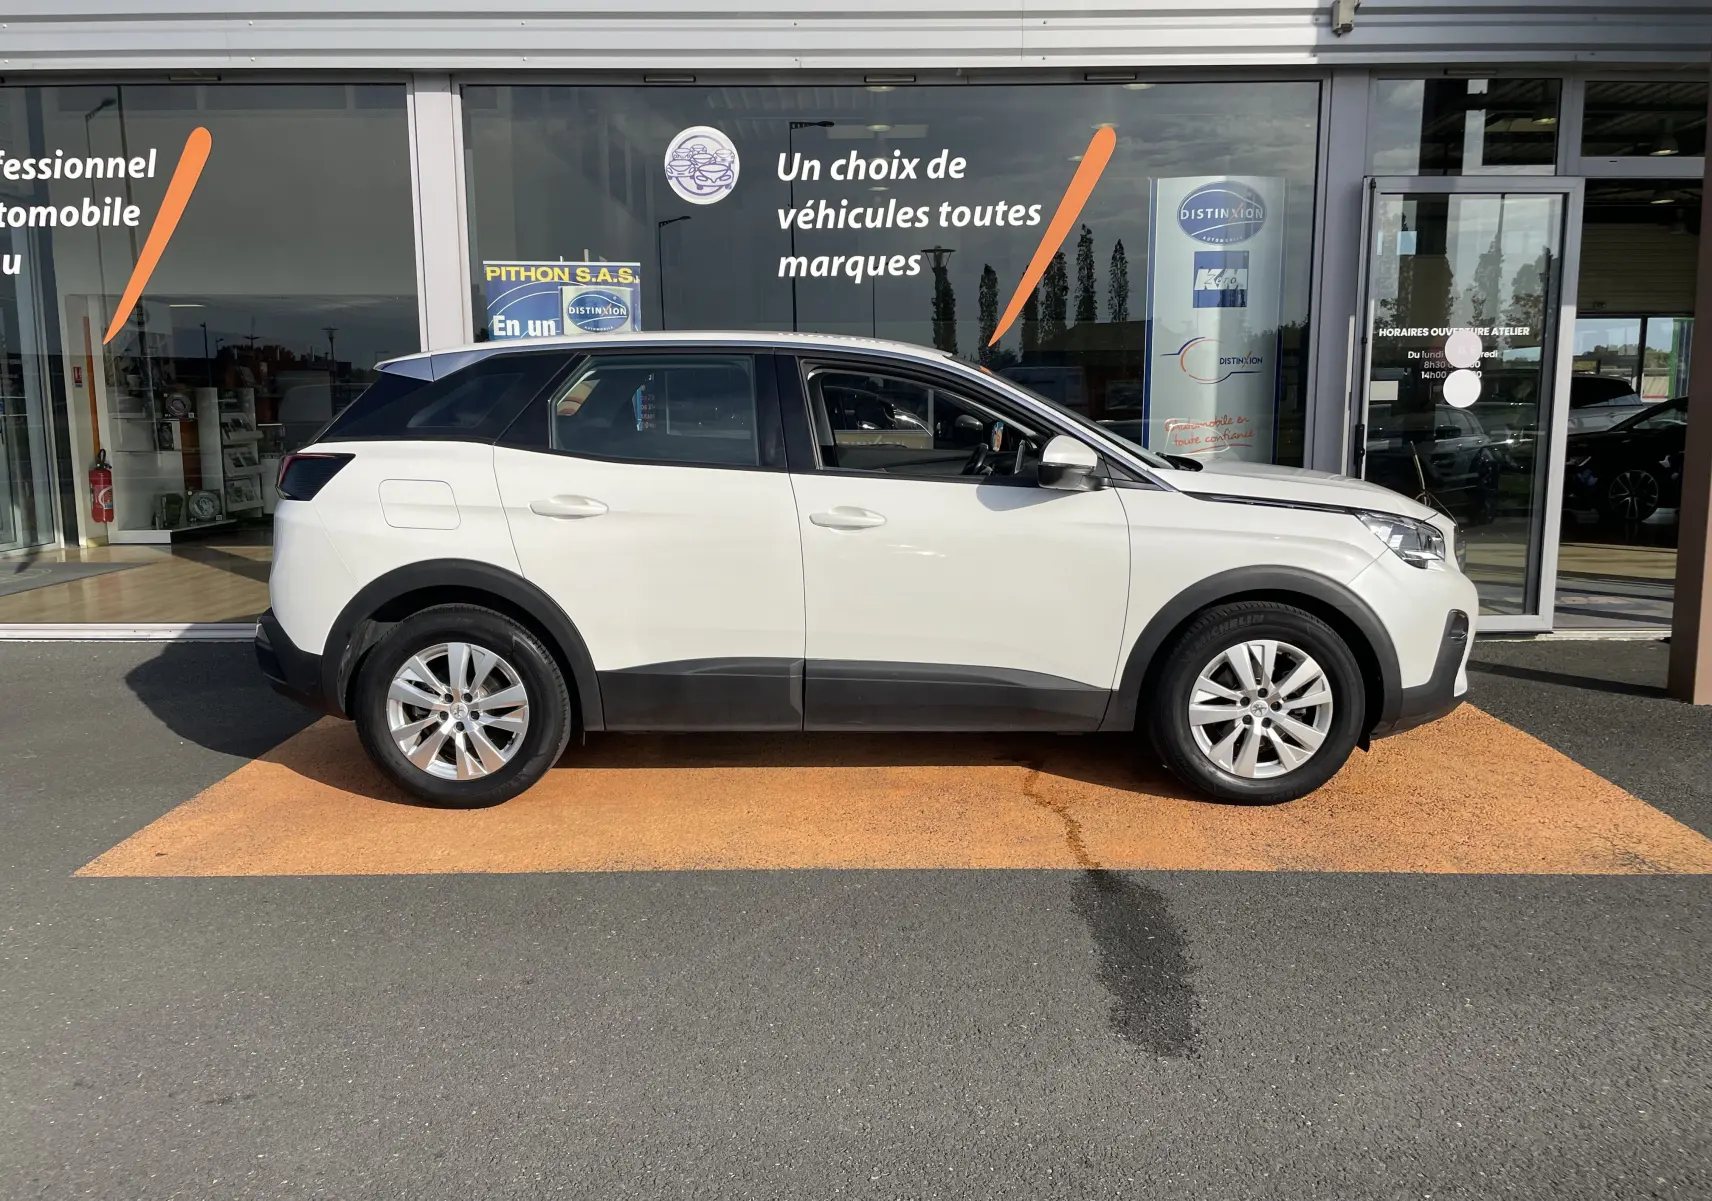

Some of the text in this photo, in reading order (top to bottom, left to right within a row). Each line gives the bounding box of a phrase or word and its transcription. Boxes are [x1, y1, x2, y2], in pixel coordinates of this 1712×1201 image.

[777, 148, 967, 181] Un choix de
[777, 198, 1042, 230] véhicules toutes
[1180, 205, 1263, 221] DISTINXION
[485, 266, 637, 284] PITHON S.A.S.
[777, 254, 922, 284] marques
[568, 304, 627, 316] DISTINXION
[493, 315, 556, 336] En un
[1378, 327, 1429, 337] HORAIRES
[1490, 326, 1530, 336] ATELIER
[1219, 355, 1263, 366] DISTINXION
[1407, 350, 1420, 359] Du
[1421, 350, 1444, 359] lundi
[1423, 360, 1446, 369] 8h30
[1421, 371, 1447, 380] 14h00
